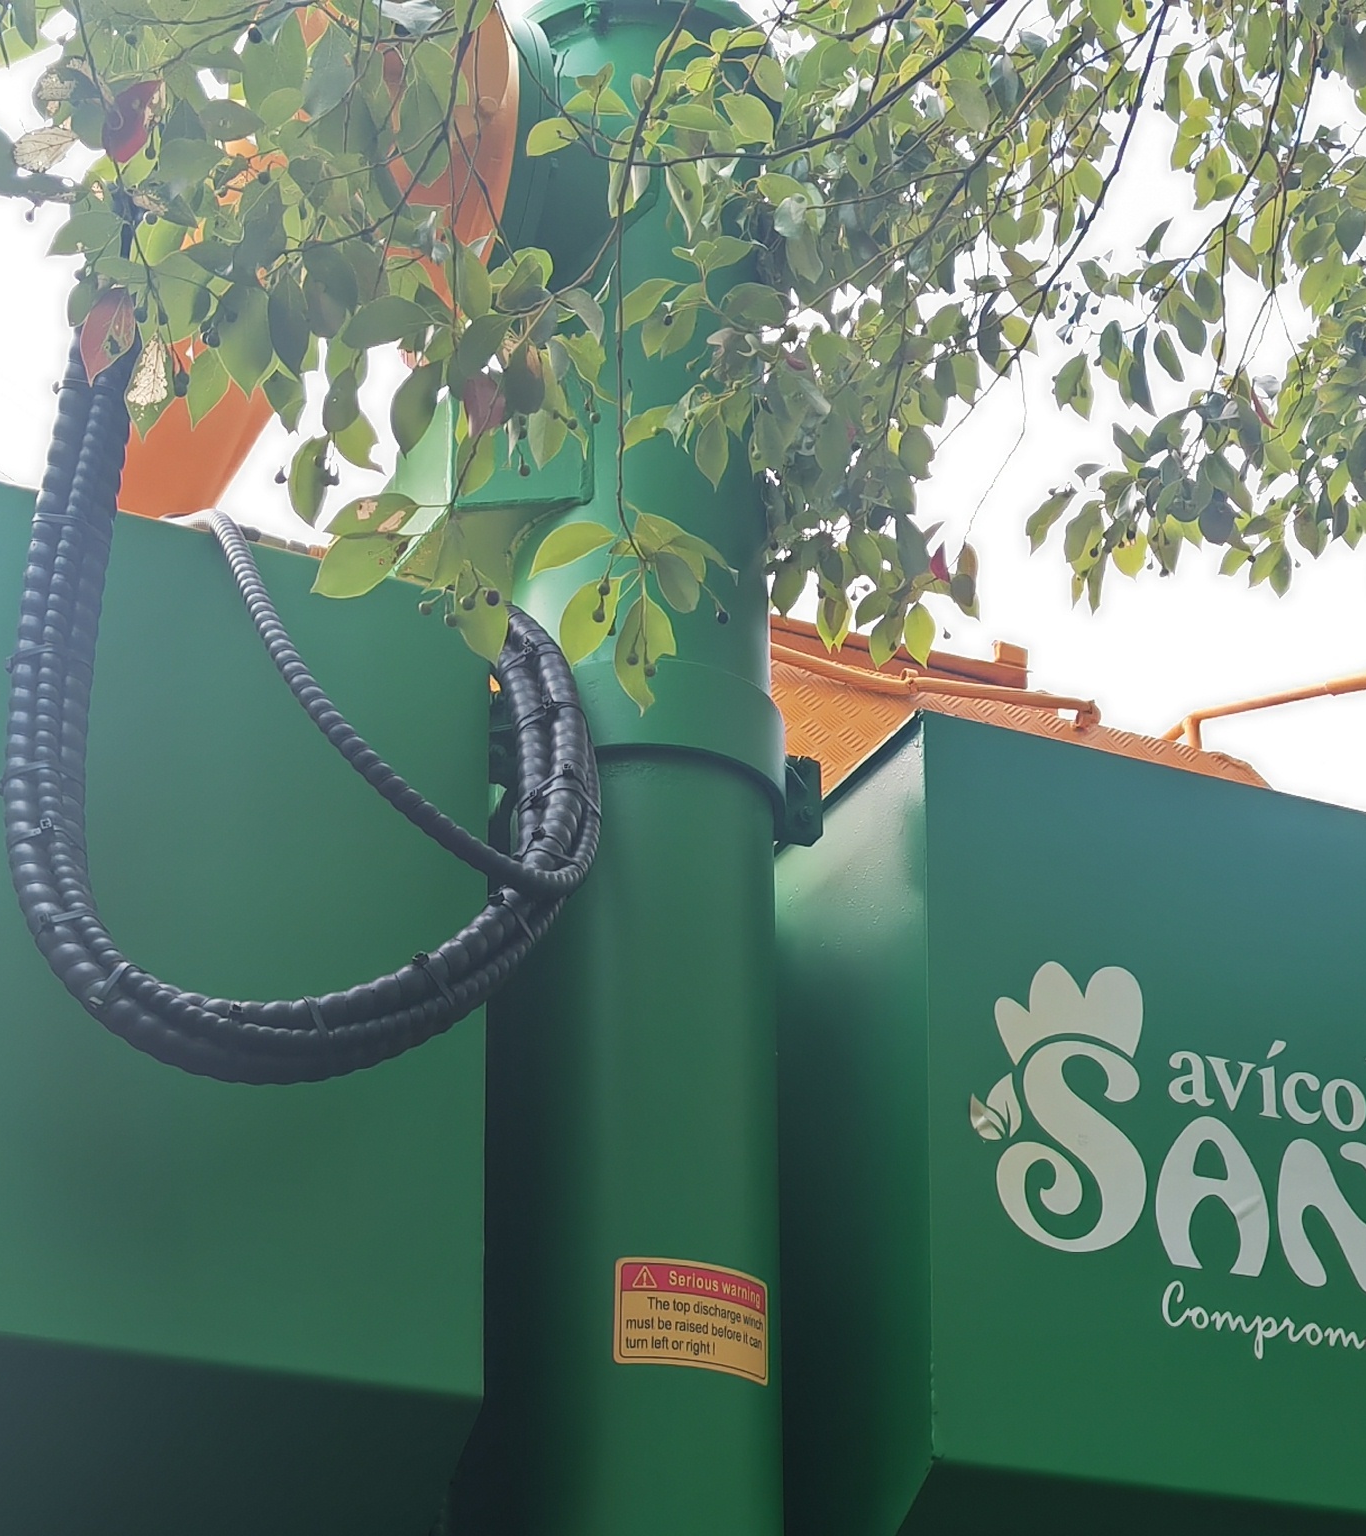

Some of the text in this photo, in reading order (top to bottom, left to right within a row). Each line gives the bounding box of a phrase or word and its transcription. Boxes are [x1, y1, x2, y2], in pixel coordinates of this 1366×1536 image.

[668, 1270, 761, 1309] Serious warning
[646, 1296, 764, 1332] The top discharge winch
[625, 1336, 648, 1350] turn
[651, 1336, 670, 1351] left
[671, 1340, 684, 1352] or
[686, 1340, 711, 1357] right
[626, 1316, 763, 1351] must be raised before it can
